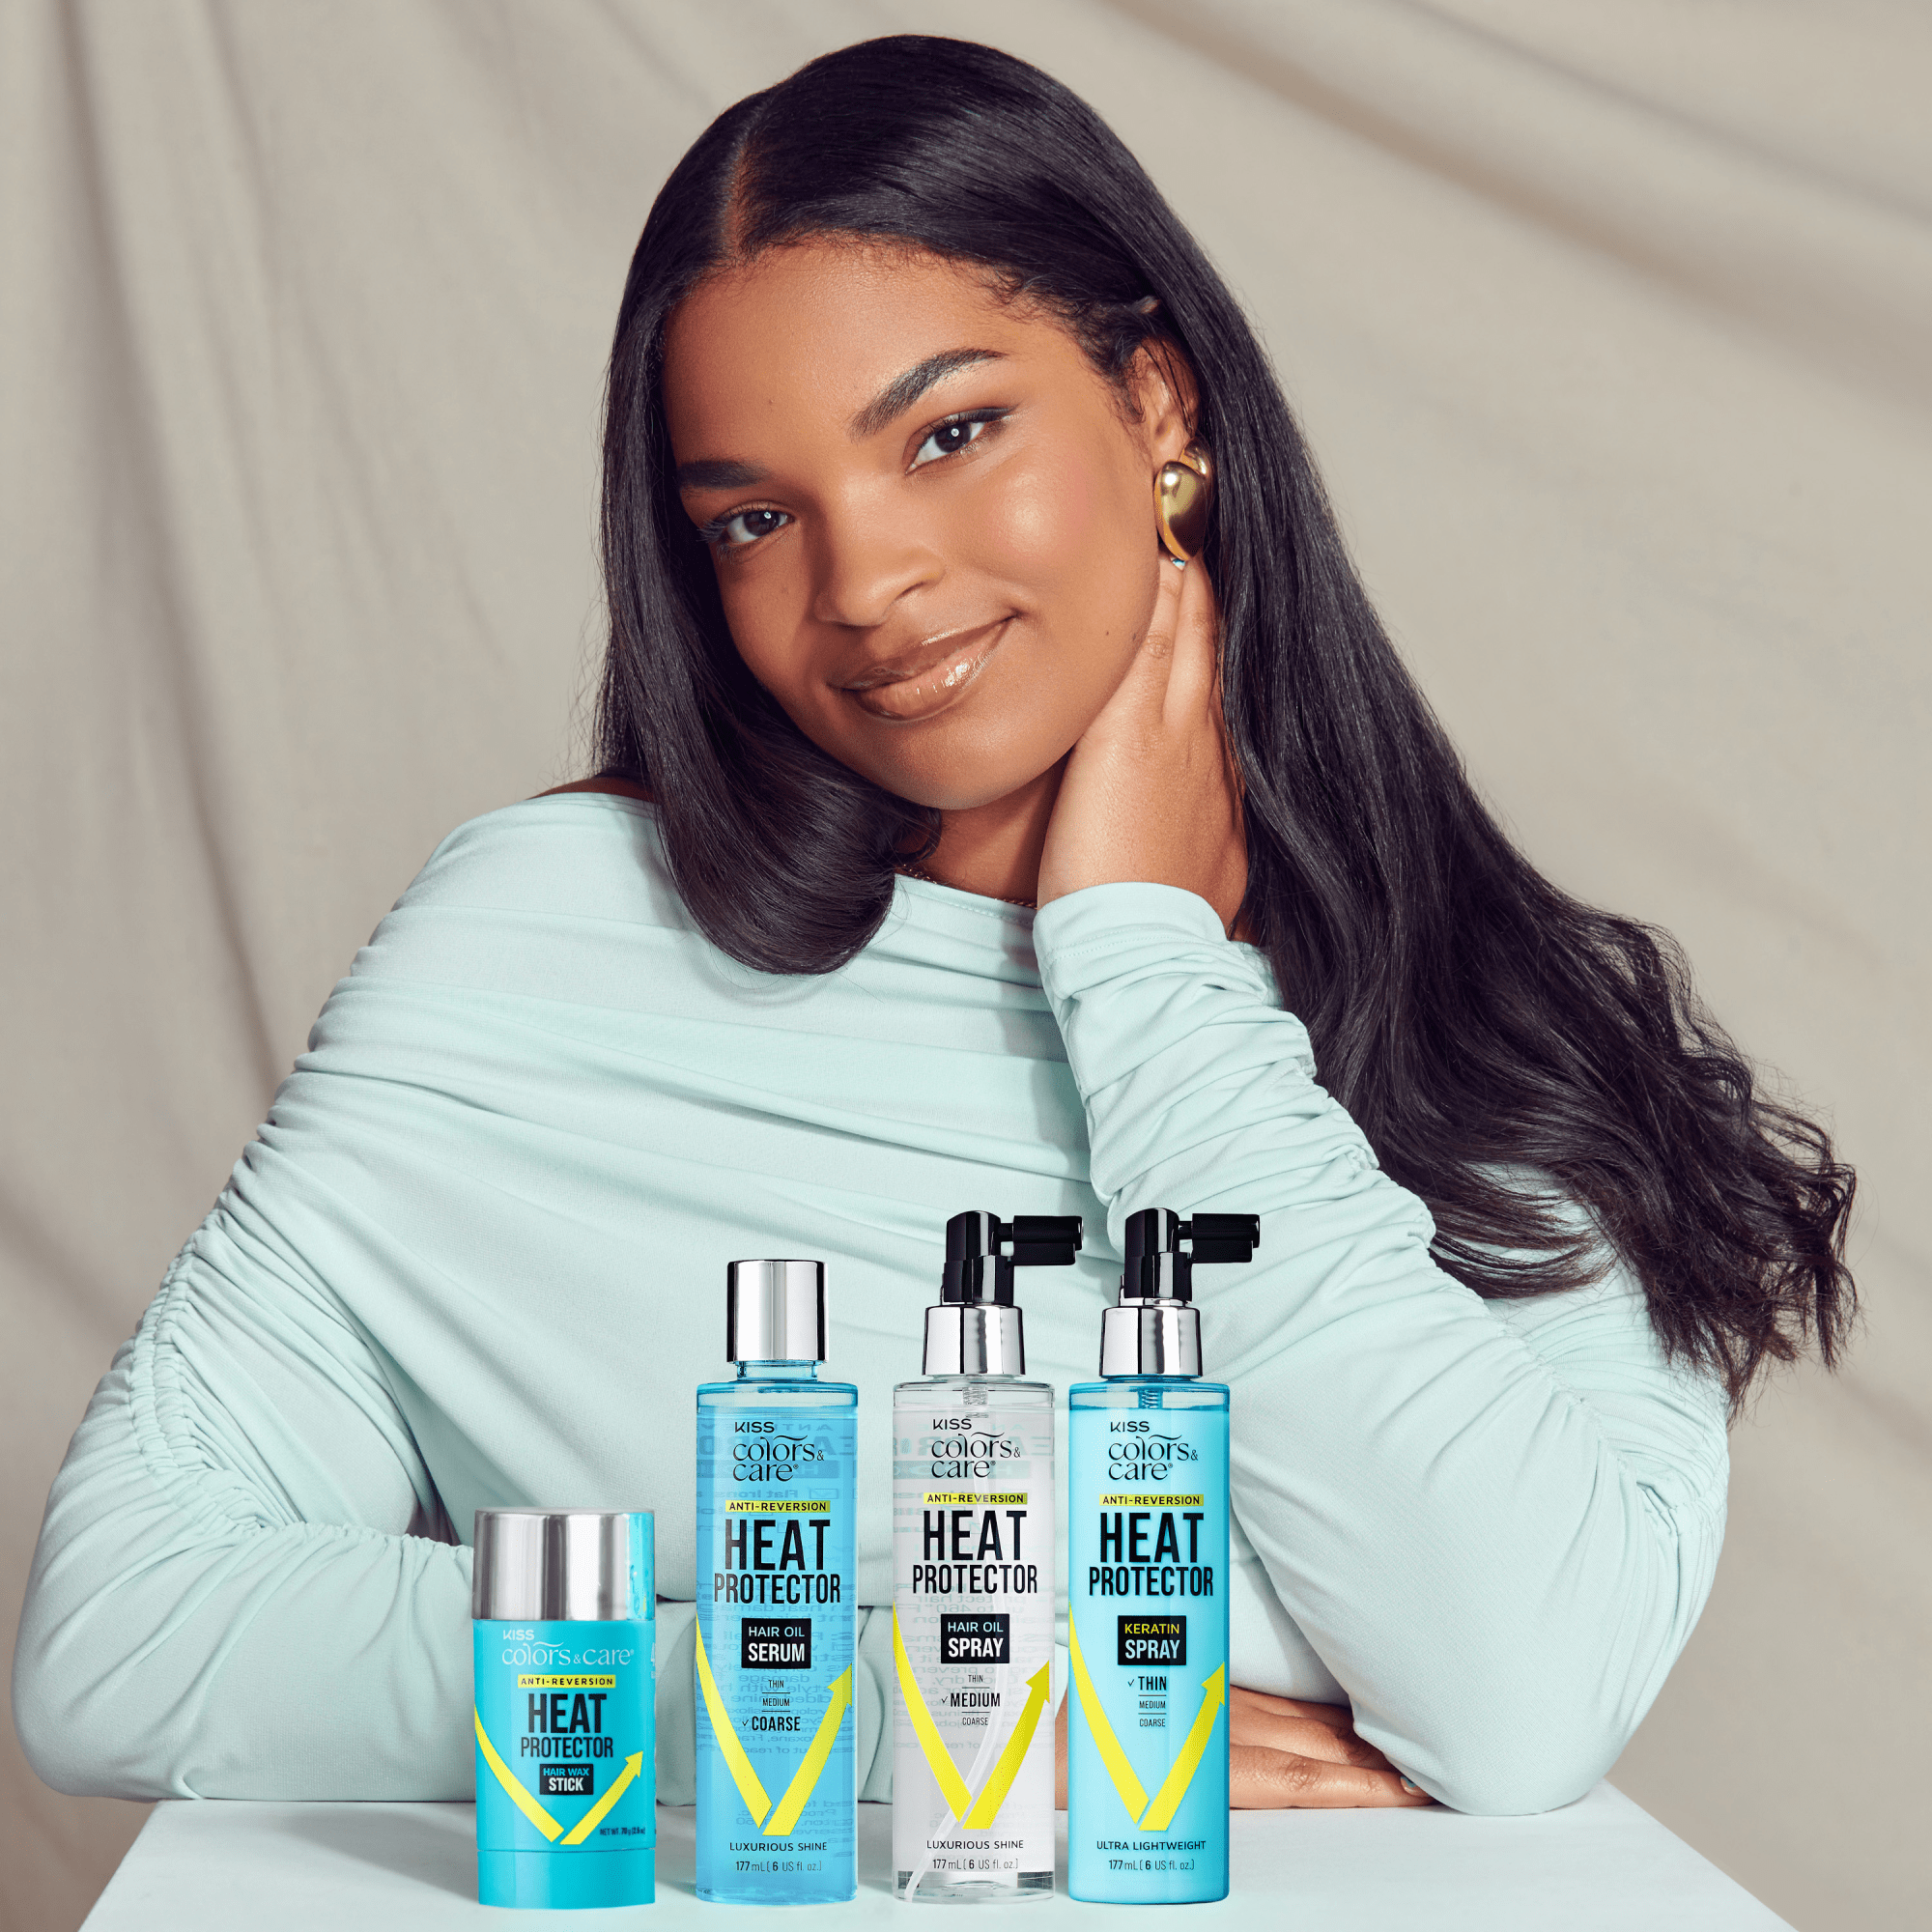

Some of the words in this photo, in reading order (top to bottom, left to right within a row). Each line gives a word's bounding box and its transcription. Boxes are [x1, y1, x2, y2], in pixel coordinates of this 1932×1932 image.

[734, 1421, 775, 1434] KISS
[933, 1418, 972, 1430] KISS
[1110, 1421, 1150, 1433] KISS
[926, 1494, 1024, 1503] ANTI-REVERSION
[1102, 1496, 1200, 1505] ANTI-REVERSION
[728, 1501, 827, 1512] ANTI-REVERSION
[923, 1510, 1027, 1561] HEAT
[1099, 1512, 1204, 1563] HEAT
[724, 1520, 831, 1571] HEAT
[913, 1564, 1037, 1594] PROTECTOR
[1089, 1566, 1213, 1597] PROTECTOR
[714, 1574, 840, 1604] PROTECTOR
[749, 1626, 780, 1637] HAIR
[784, 1626, 805, 1637] OIL
[948, 1622, 978, 1633] HAIR
[983, 1622, 1004, 1633] OIL
[1124, 1623, 1179, 1634] KERATIN
[502, 1630, 535, 1640] KISS
[748, 1643, 805, 1662] SERUM
[948, 1637, 1004, 1658] SPRAY
[1124, 1639, 1180, 1660] SPRAY
[521, 1677, 613, 1686] ANTI-REVERSION
[769, 1679, 784, 1689] THIN
[968, 1674, 983, 1683] THIN
[1138, 1676, 1167, 1690] THIN
[762, 1698, 790, 1707] MEDIUM
[951, 1692, 1001, 1707] MEDIUM
[1139, 1700, 1166, 1709] MEDIUM
[528, 1693, 607, 1733] HEAT
[752, 1717, 800, 1731] COARSE
[962, 1718, 988, 1726] COARSE
[1139, 1719, 1166, 1727] COARSE
[521, 1737, 613, 1757] PROTECTOR
[543, 1768, 566, 1776] HAIR
[568, 1768, 589, 1776] WAX
[548, 1776, 583, 1792] STICK
[729, 1842, 794, 1852] LUXURIOUS
[798, 1841, 827, 1851] SHINE
[926, 1840, 990, 1850] LUXURIOUS
[994, 1840, 1024, 1849] SHINE
[1096, 1840, 1129, 1850] ULTRA
[1133, 1840, 1207, 1850] LIGHTWEIGHT
[782, 1861, 794, 1872] US
[978, 1859, 990, 1870] US
[1155, 1860, 1167, 1871] US
